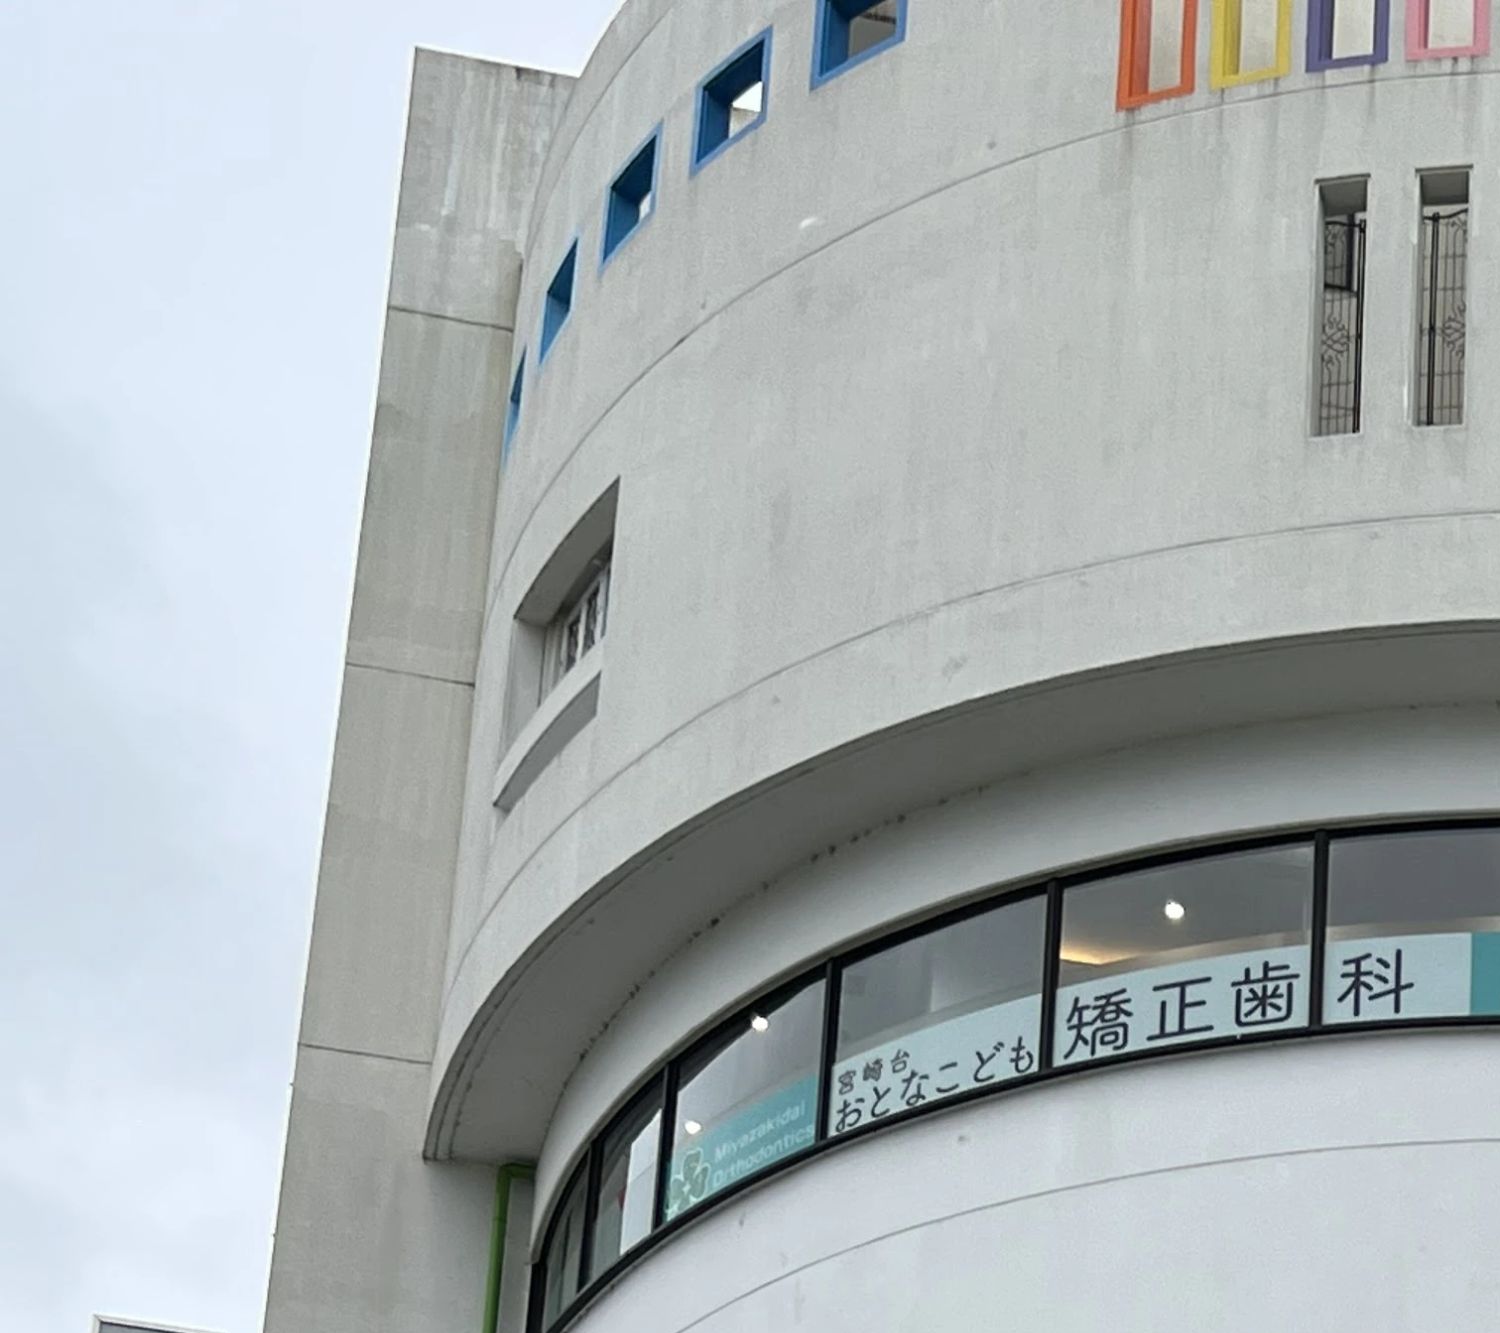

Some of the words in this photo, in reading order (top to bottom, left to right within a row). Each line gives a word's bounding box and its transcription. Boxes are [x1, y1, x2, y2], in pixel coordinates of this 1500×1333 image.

[1062, 948, 1415, 1060] 矯正歯科
[834, 1036, 1035, 1133] おとなこども
[837, 1049, 912, 1095] 宮崎台
[710, 1124, 815, 1187] Orthodontics
